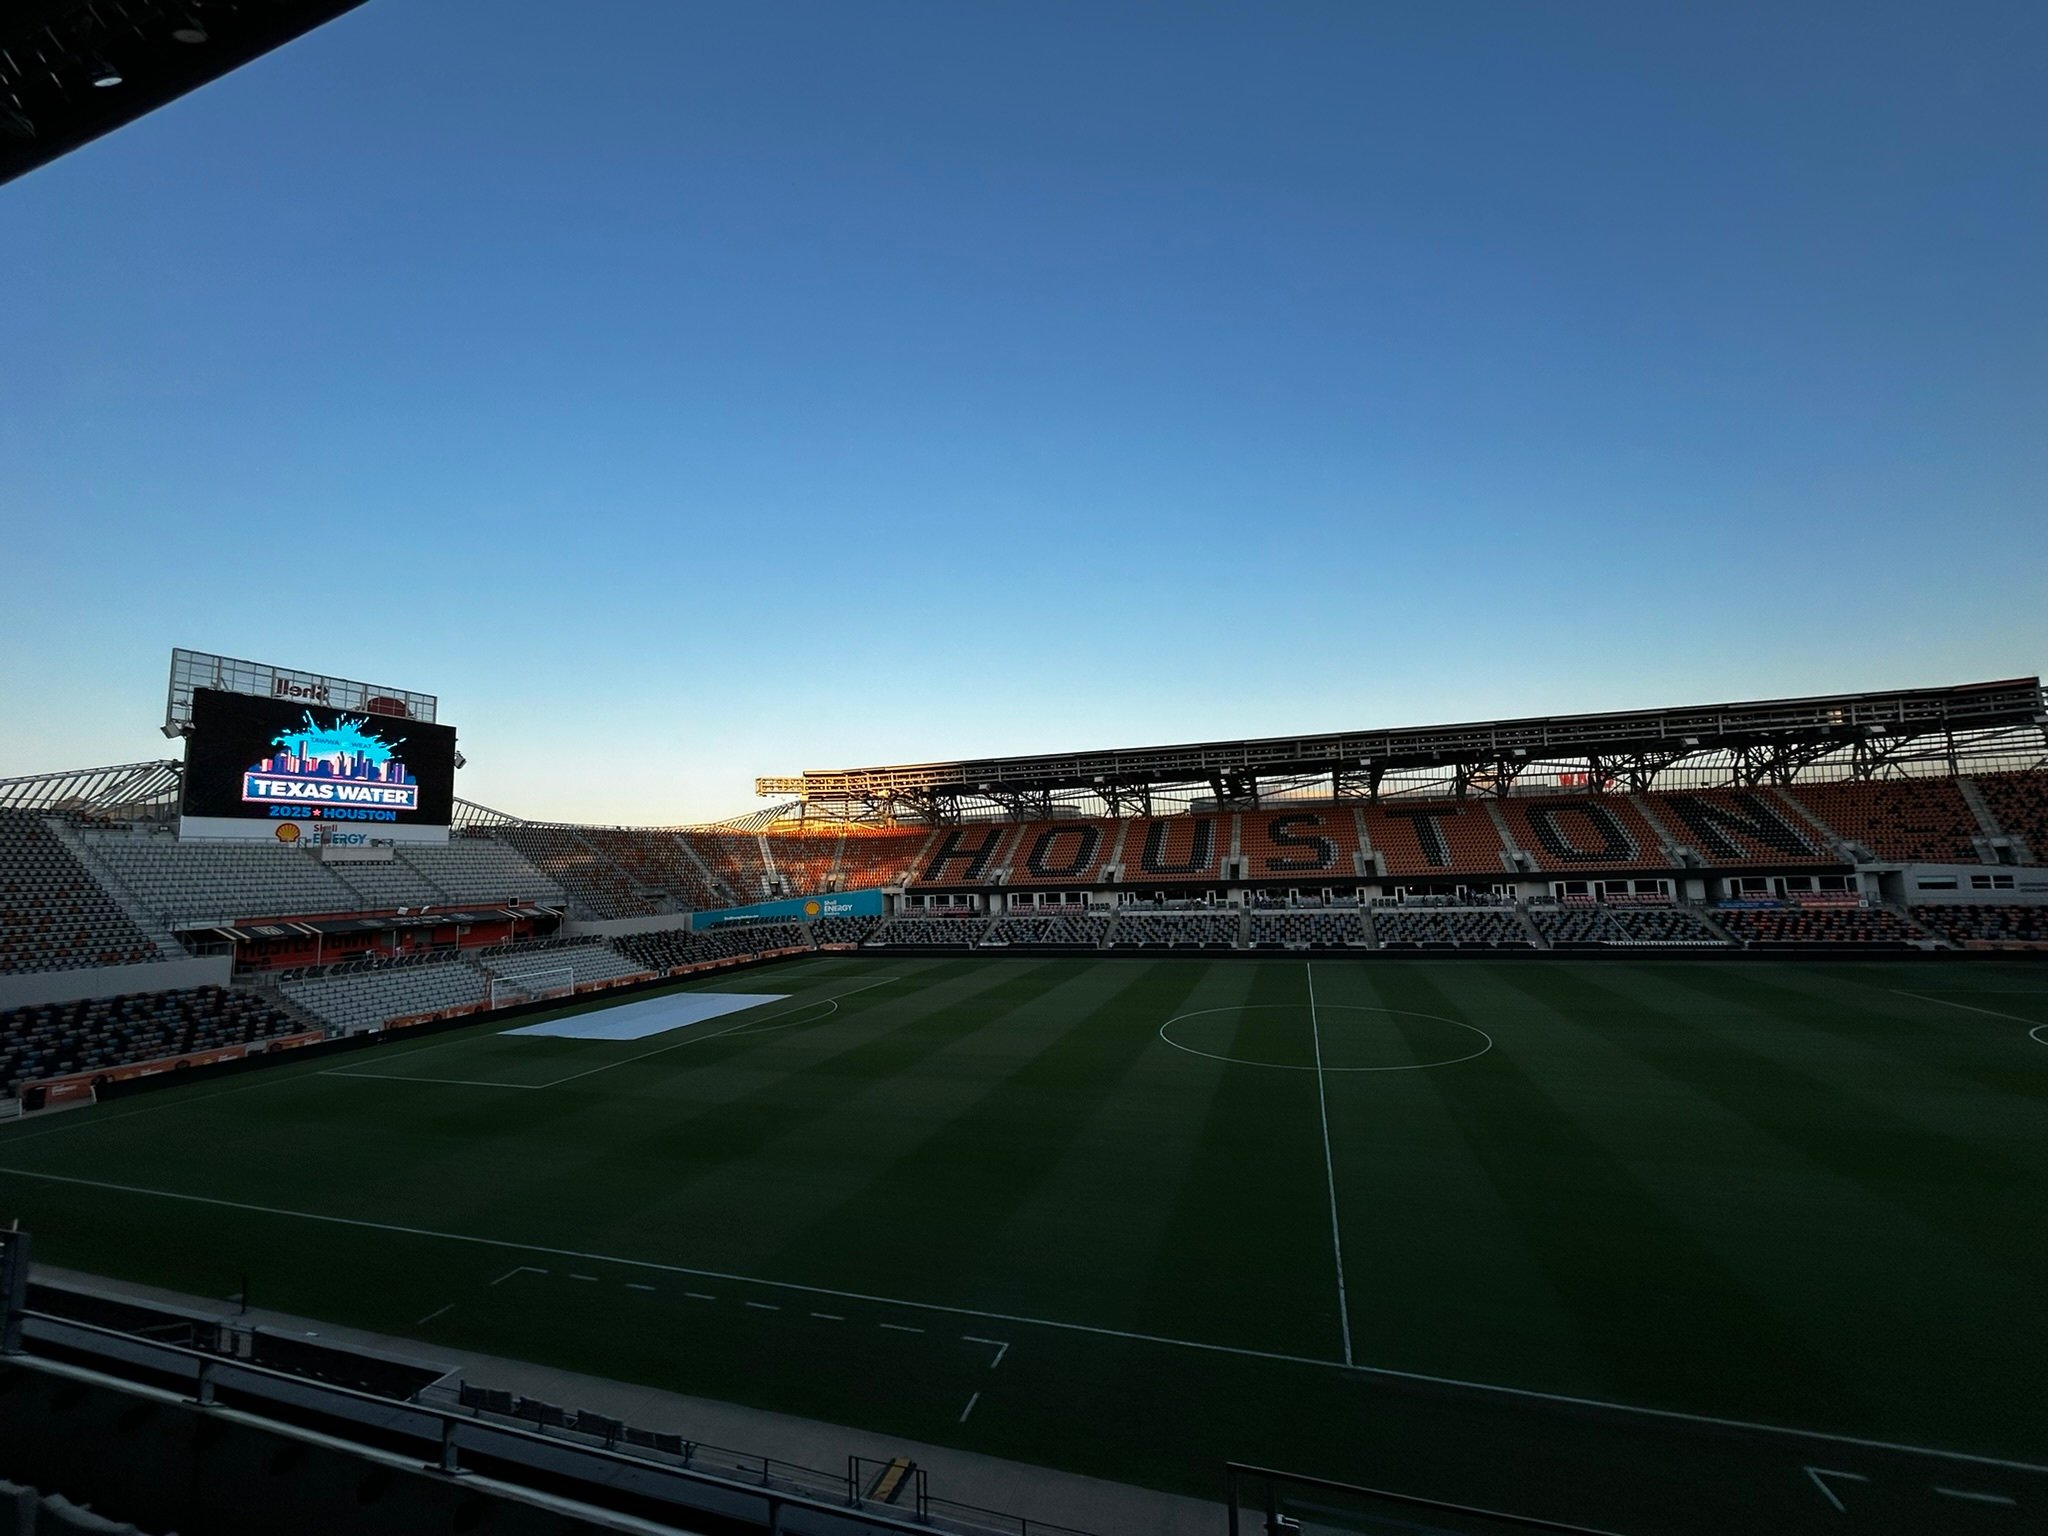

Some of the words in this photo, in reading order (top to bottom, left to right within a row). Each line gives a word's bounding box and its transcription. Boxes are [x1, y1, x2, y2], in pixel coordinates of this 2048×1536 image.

[254, 779, 334, 800] TEXAS
[337, 785, 410, 804] WATER
[269, 805, 312, 818] 2025
[322, 808, 396, 822] HOUSTON
[313, 833, 368, 845] EERGY
[920, 793, 1829, 881] HOUSTON
[823, 904, 853, 912] ENERGY
